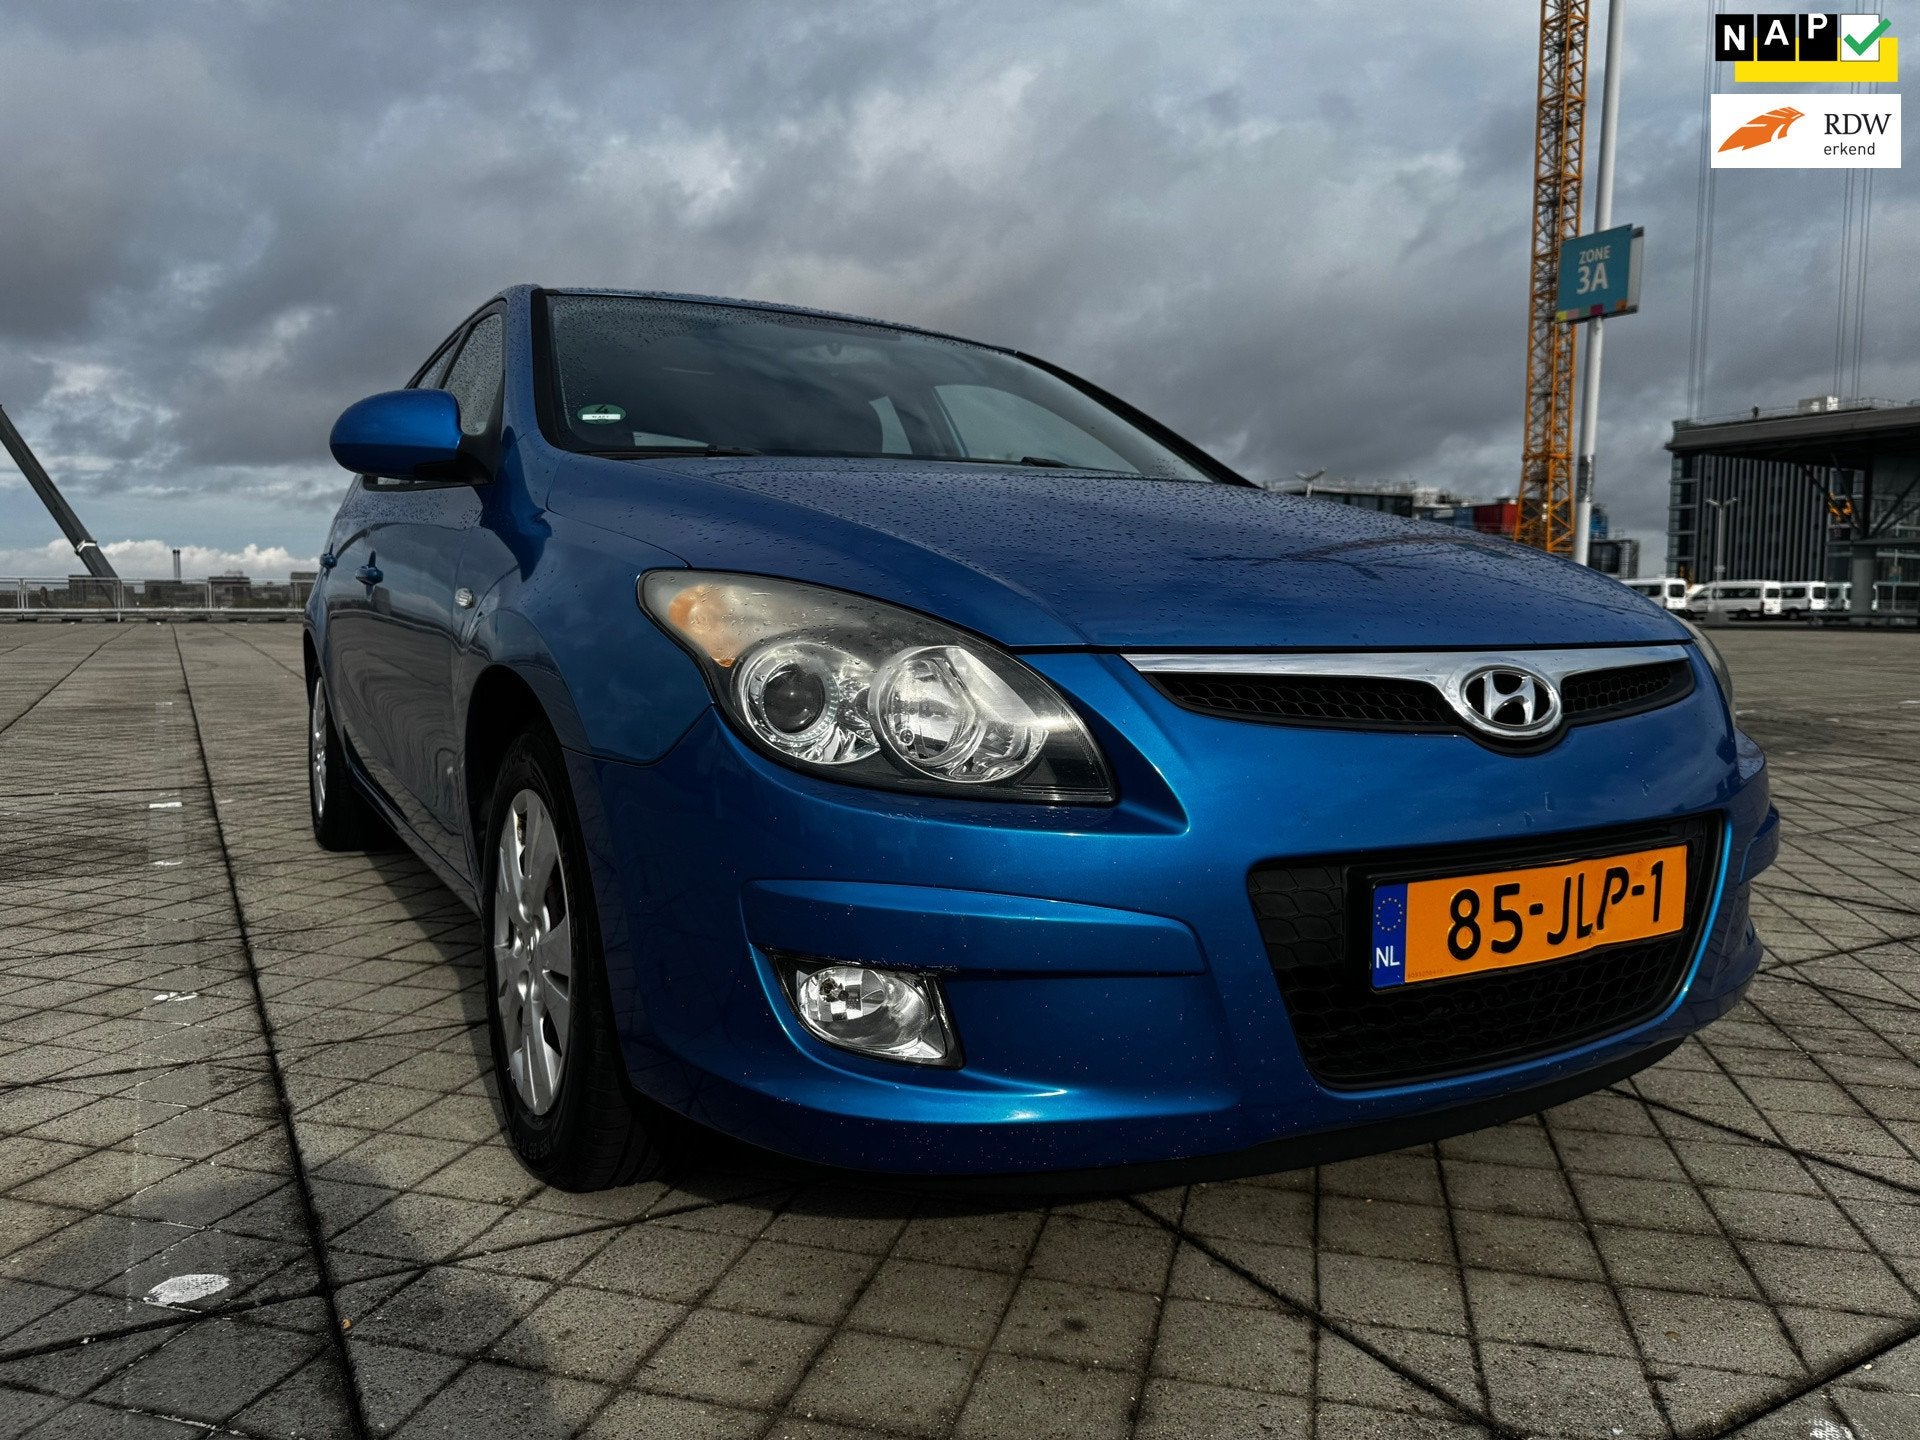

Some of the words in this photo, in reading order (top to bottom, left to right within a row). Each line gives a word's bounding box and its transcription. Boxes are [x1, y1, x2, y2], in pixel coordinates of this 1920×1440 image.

[1579, 245, 1611, 265] ZONE
[1576, 262, 1608, 295] 3A
[1447, 860, 1664, 961] 85-JLP-1
[1376, 945, 1400, 969] NL
